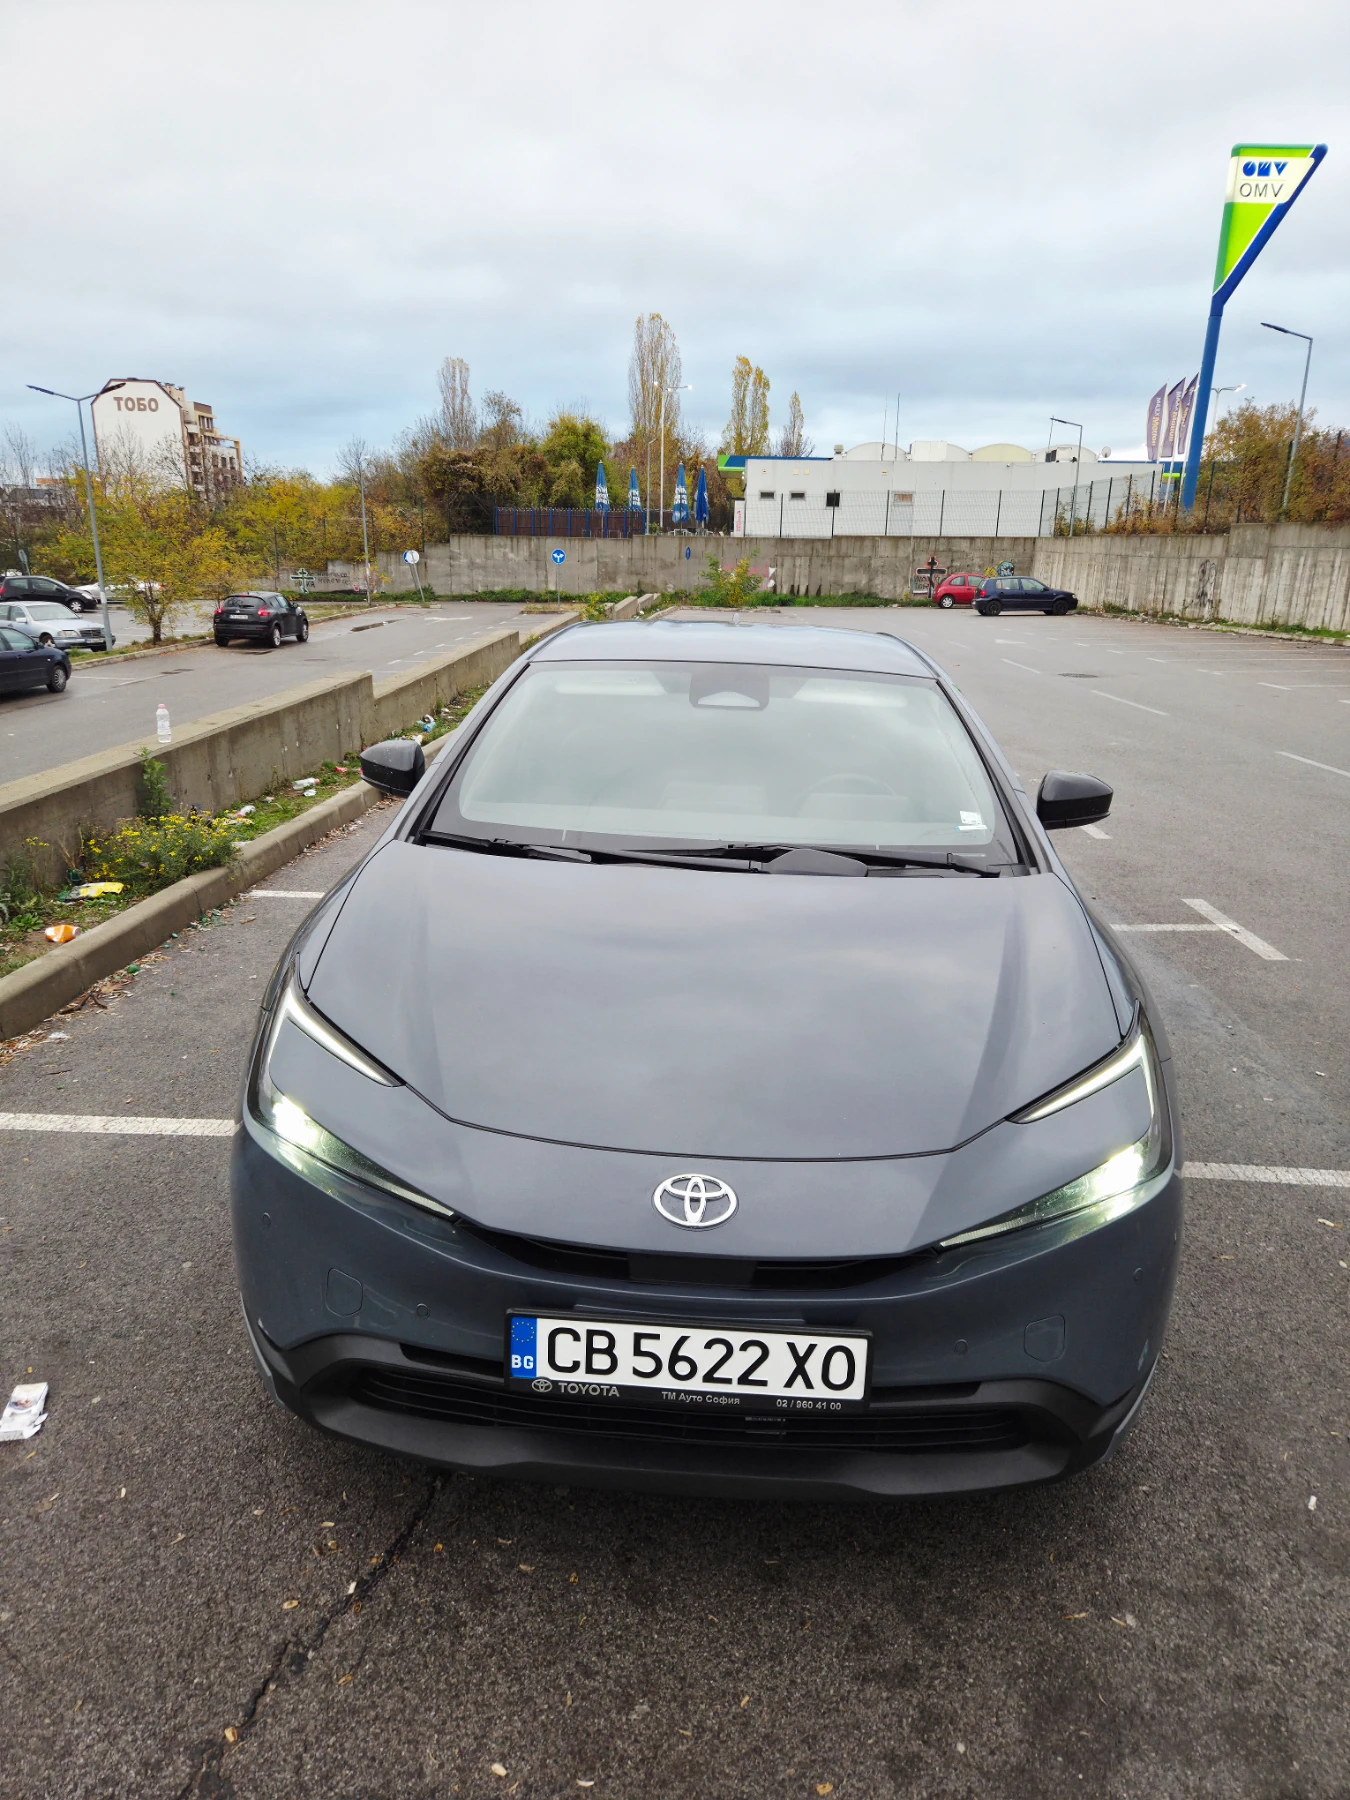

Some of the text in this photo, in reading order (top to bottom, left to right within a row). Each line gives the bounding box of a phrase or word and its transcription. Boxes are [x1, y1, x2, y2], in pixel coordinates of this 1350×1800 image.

[1242, 161, 1289, 177] OMV
[1239, 182, 1284, 198] OMV
[113, 396, 159, 412] ТОБО
[511, 1354, 534, 1369] BG
[548, 1327, 856, 1391] CB 5622 XO
[558, 1382, 620, 1397] TOYOTA
[661, 1391, 740, 1405] ТМ Ауто София
[776, 1399, 789, 1408] 02
[796, 1400, 813, 1409] 960
[815, 1401, 827, 1409] 41
[830, 1402, 842, 1410] 00
